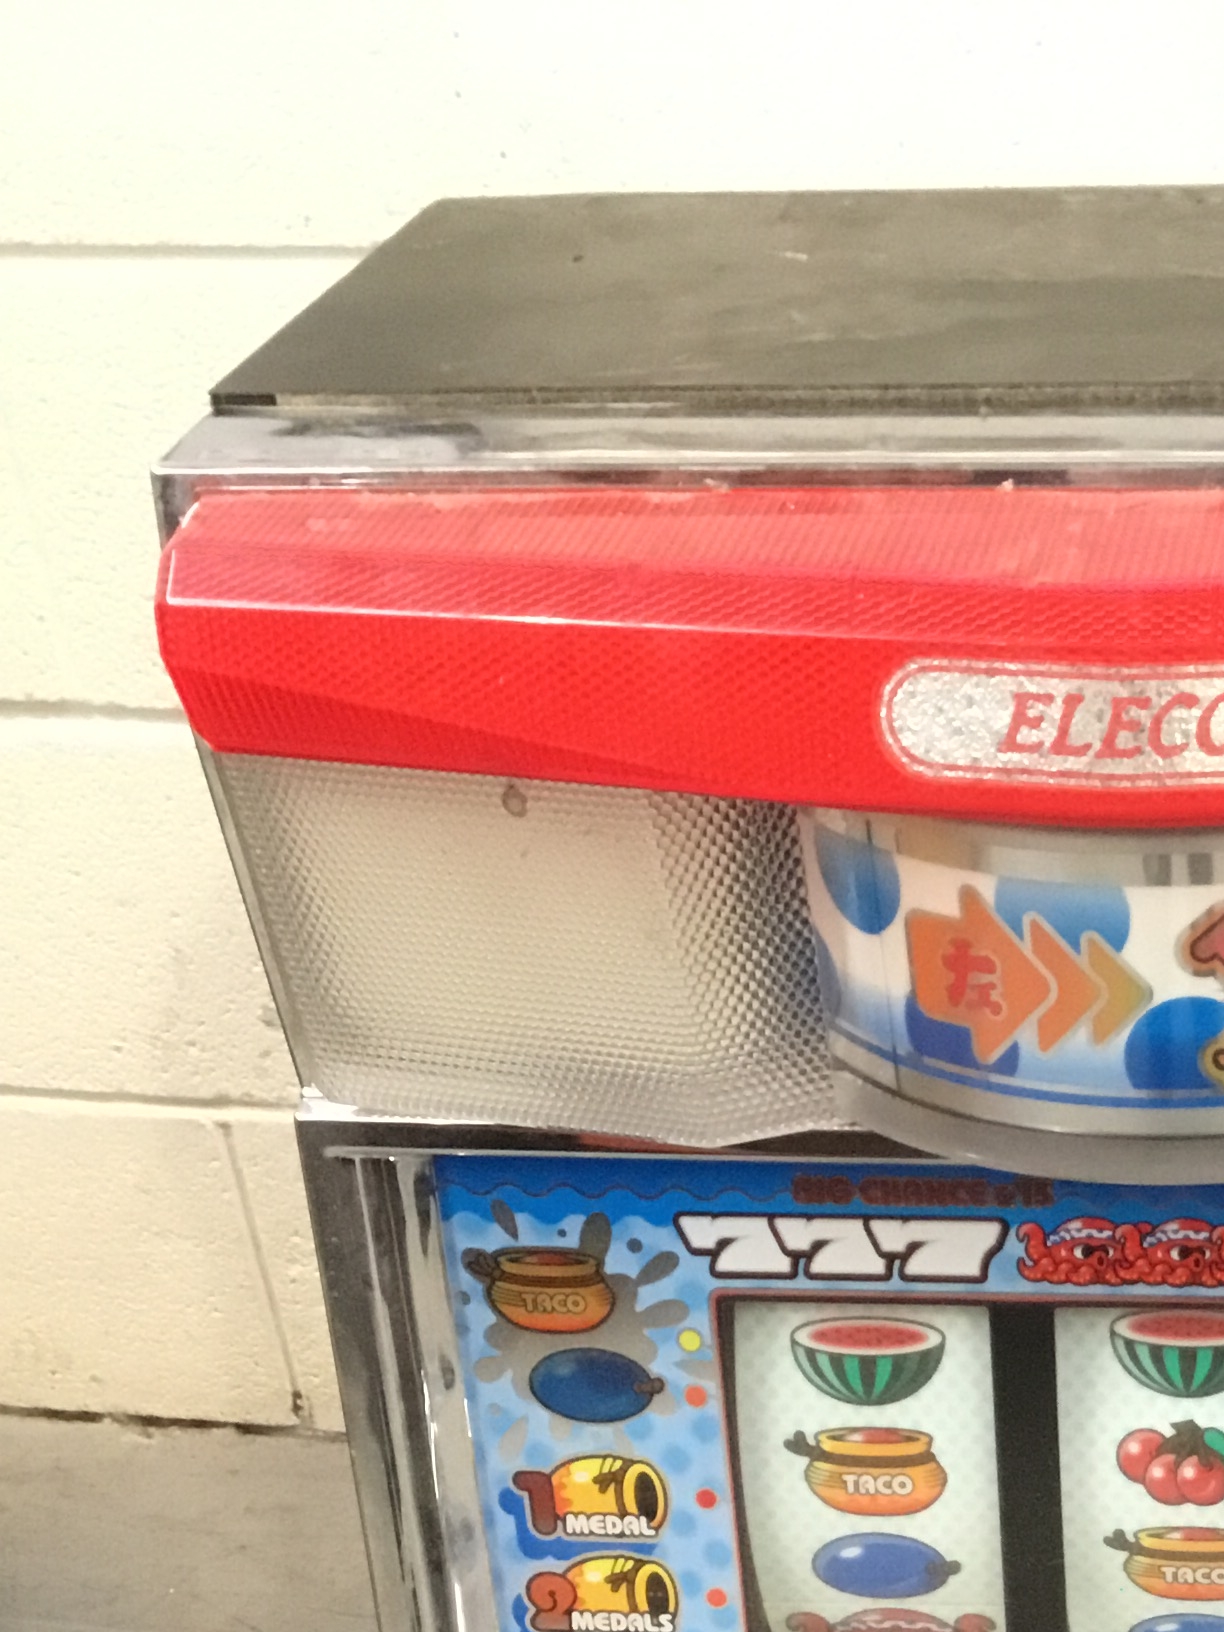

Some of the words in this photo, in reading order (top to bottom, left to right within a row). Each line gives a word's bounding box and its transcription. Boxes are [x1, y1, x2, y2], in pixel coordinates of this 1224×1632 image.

[674, 1213, 1006, 1282] 777
[521, 1291, 587, 1315] TACO
[841, 1473, 914, 1497] TACO
[564, 1514, 657, 1537] MEDAL
